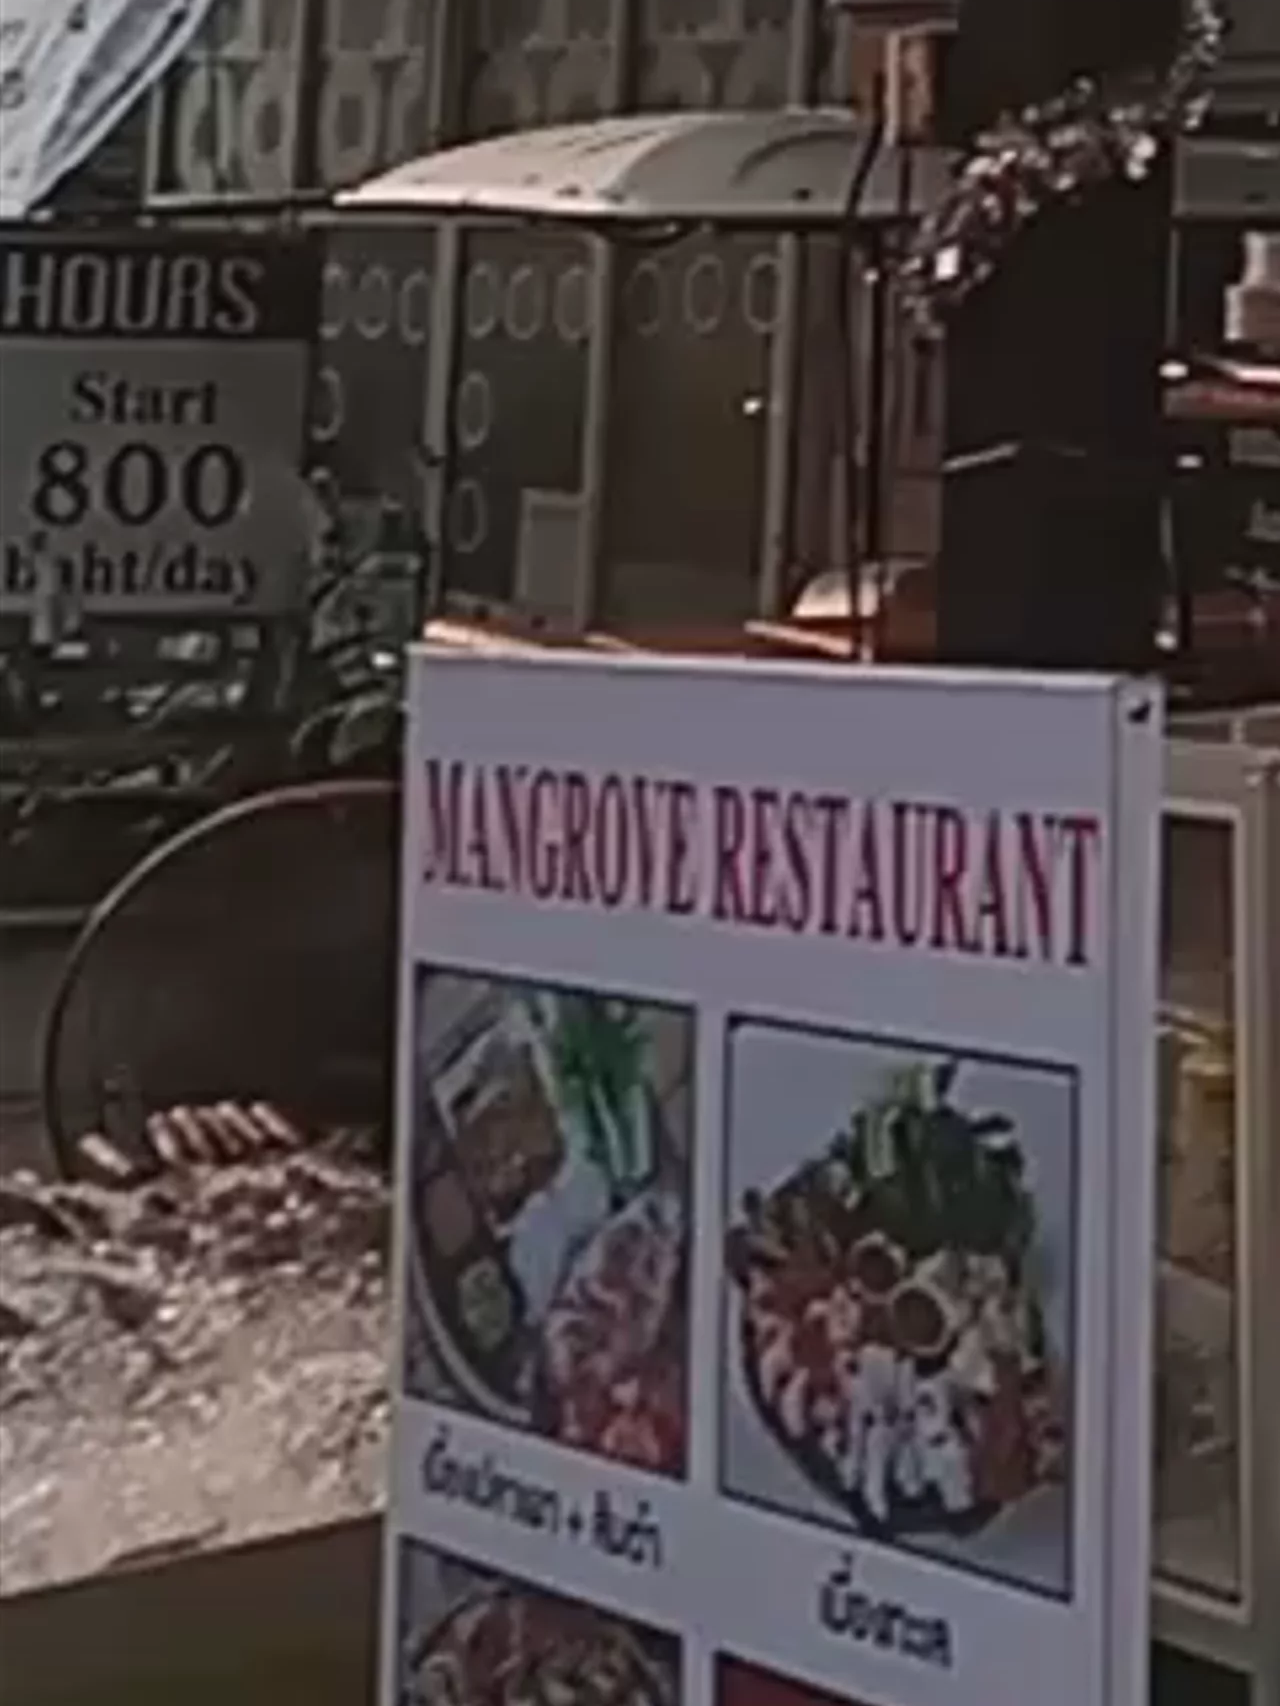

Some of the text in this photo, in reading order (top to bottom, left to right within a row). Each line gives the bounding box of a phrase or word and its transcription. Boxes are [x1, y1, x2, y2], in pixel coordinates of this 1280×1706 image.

[3, 250, 265, 334] HOURS
[69, 372, 217, 426] Start
[33, 439, 244, 528] 800
[423, 758, 1099, 966] MANGROVE RESTAURANT
